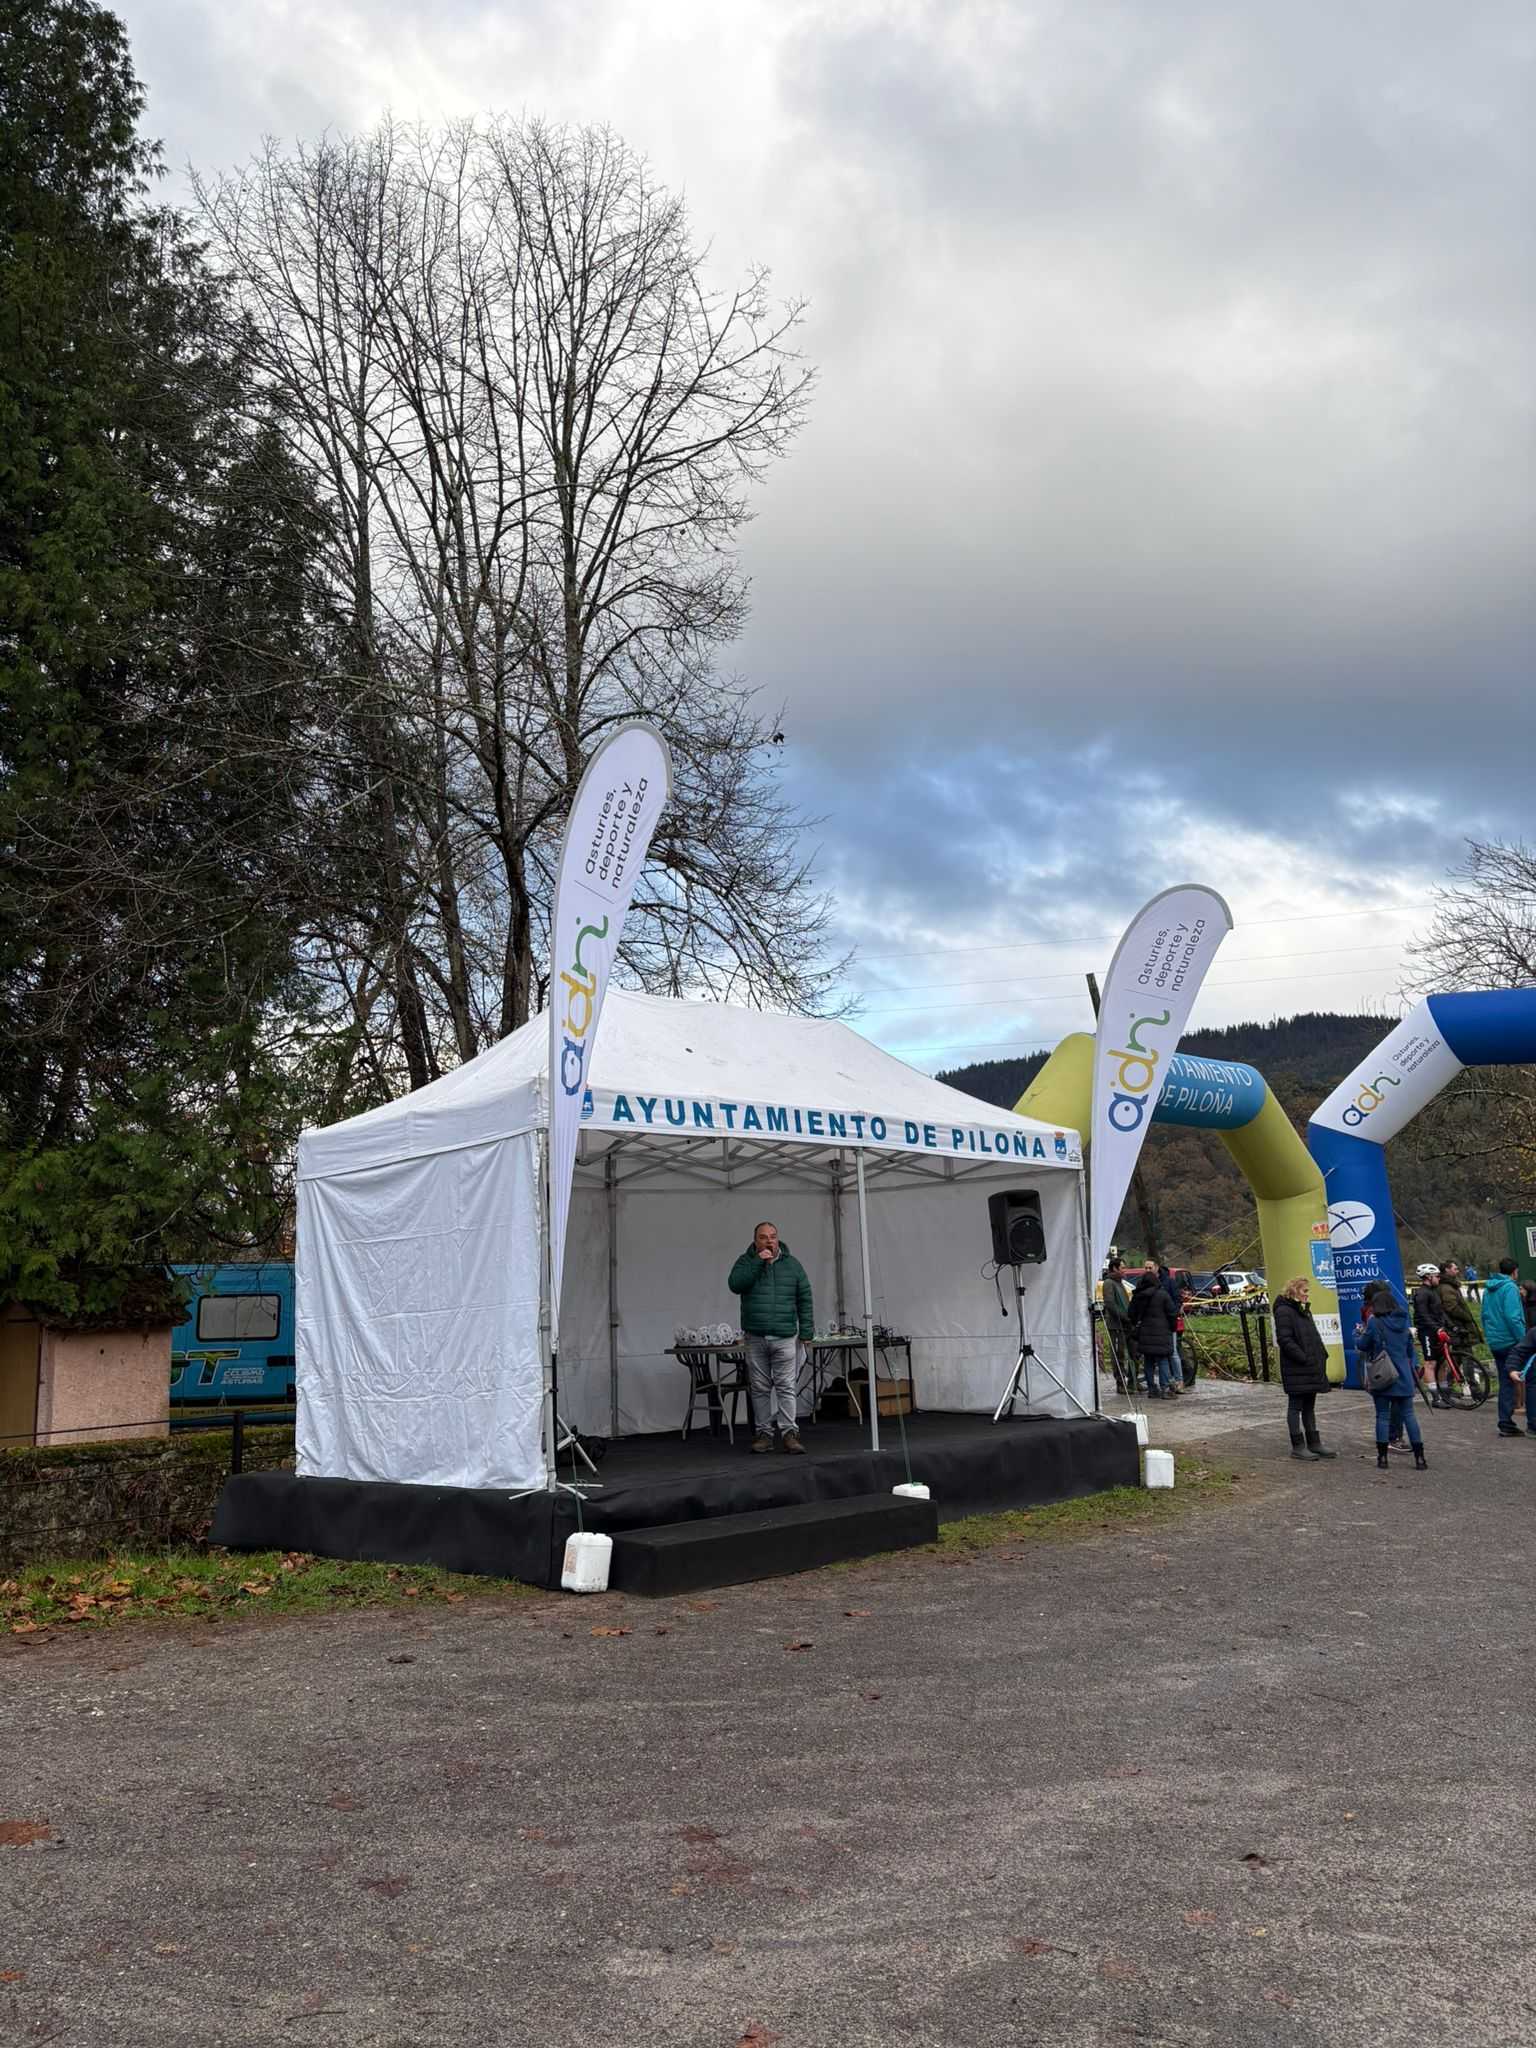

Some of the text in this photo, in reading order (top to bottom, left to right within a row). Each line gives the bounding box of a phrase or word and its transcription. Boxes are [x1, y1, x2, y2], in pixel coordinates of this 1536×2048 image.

[600, 782, 633, 880] deporte y
[612, 777, 648, 889] naturaleza
[1155, 922, 1189, 988] deporte y
[1171, 919, 1205, 992] naturaleza
[612, 1094, 1046, 1158] AYUNTAMIENTO DE PILOÑA
[1174, 1087, 1233, 1115] PILOÑA
